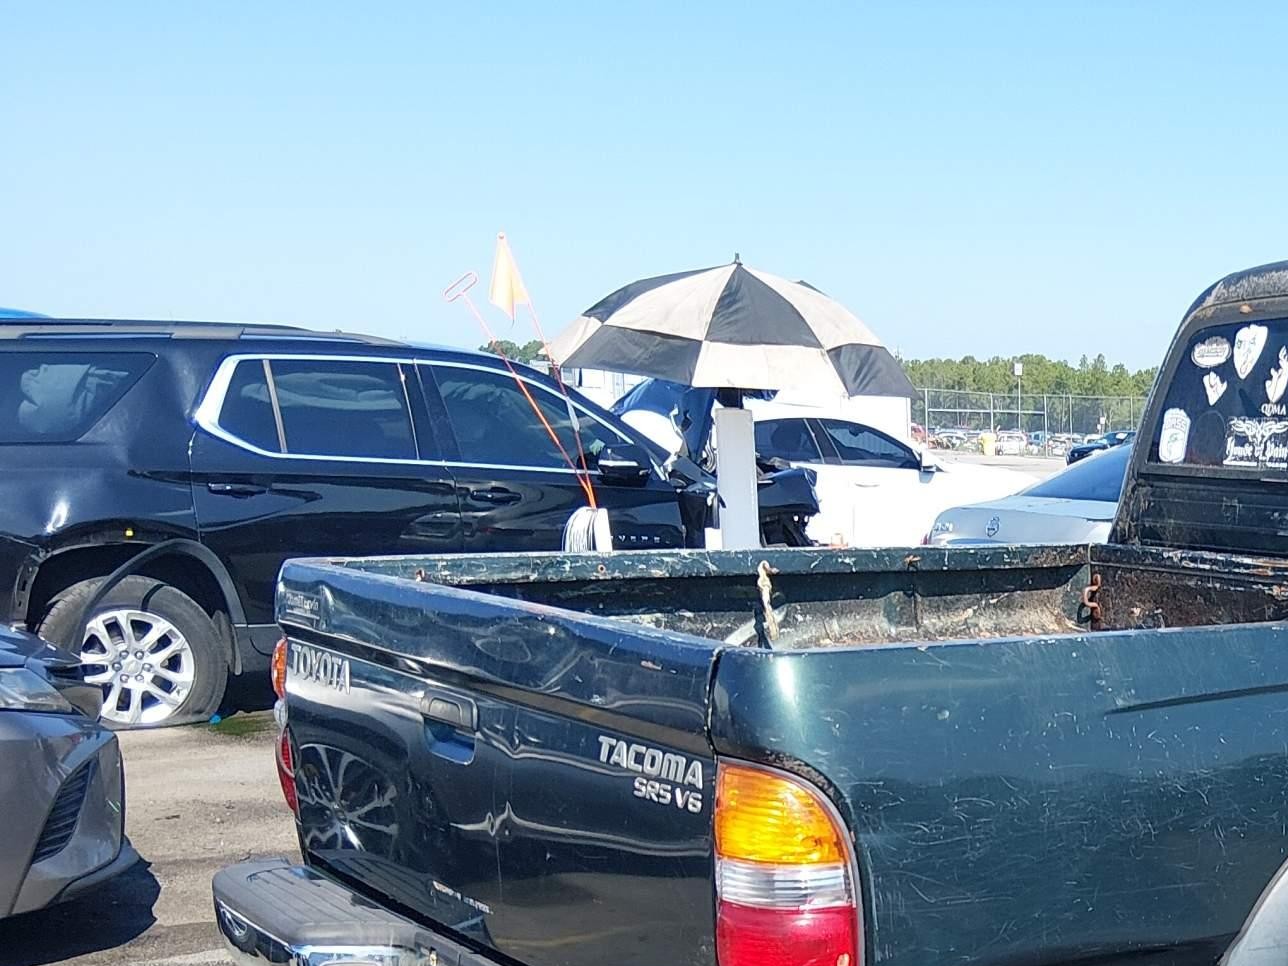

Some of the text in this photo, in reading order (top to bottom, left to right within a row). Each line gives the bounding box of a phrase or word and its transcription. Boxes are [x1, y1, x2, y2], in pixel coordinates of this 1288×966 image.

[291, 643, 351, 695] TOYOTA
[598, 735, 703, 790] TACOMA
[675, 787, 703, 813] V6
